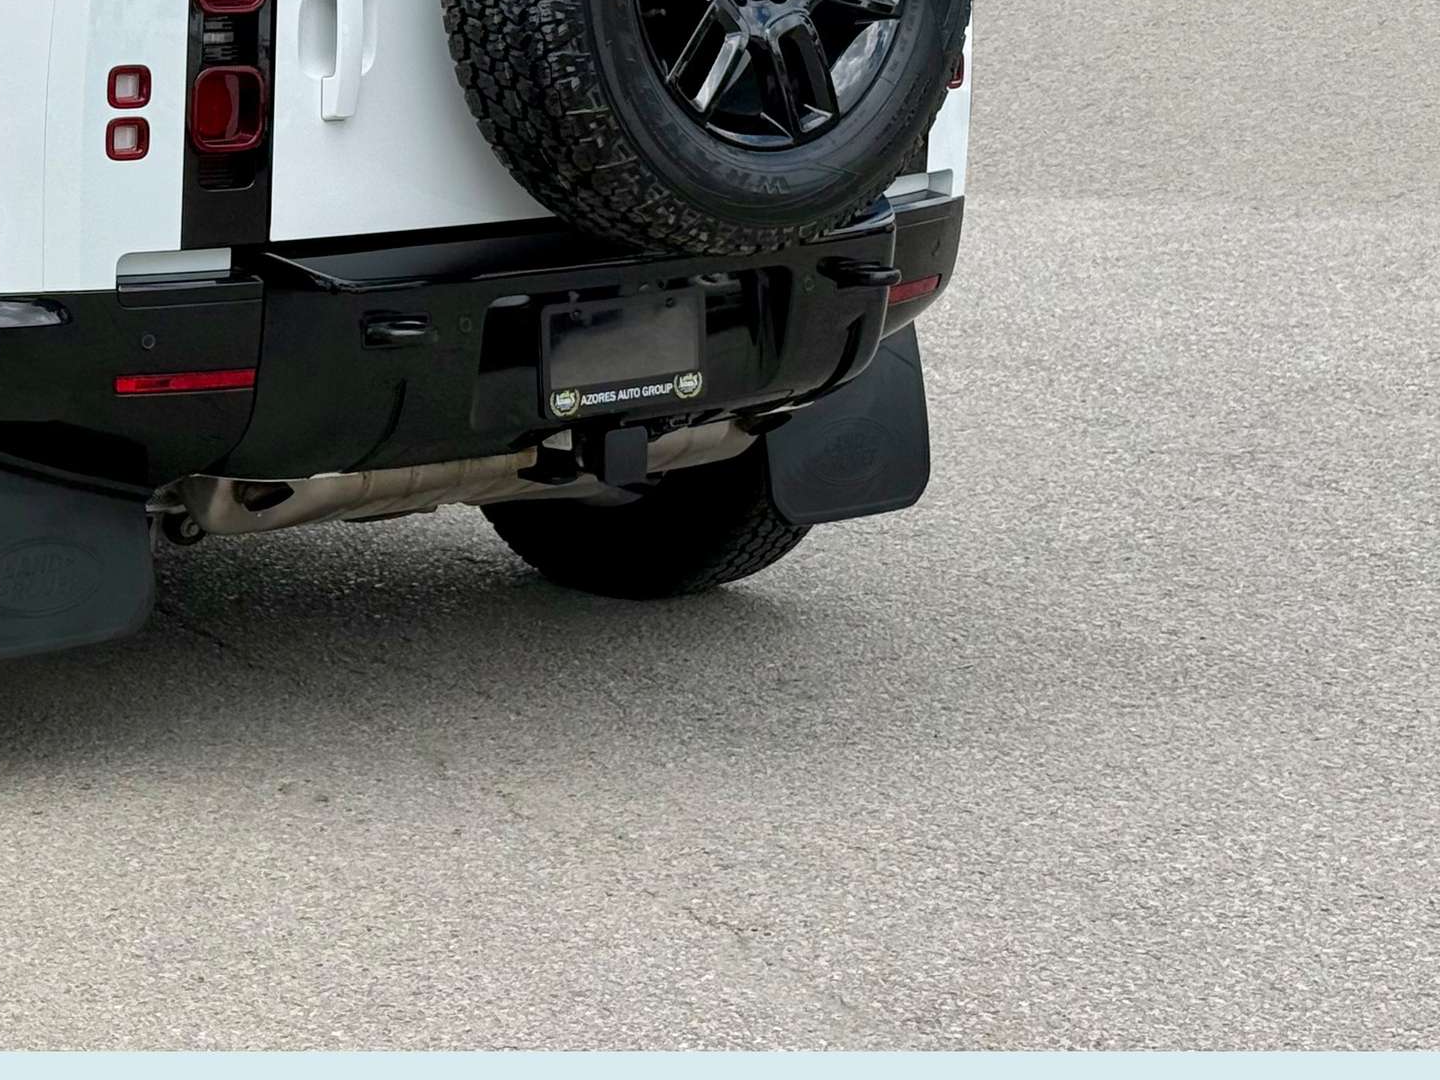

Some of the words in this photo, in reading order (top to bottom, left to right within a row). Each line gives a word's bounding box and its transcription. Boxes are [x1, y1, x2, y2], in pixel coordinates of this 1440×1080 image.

[580, 391, 617, 406] AZORES
[617, 388, 640, 401] AUTO
[642, 383, 673, 397] GROUP
